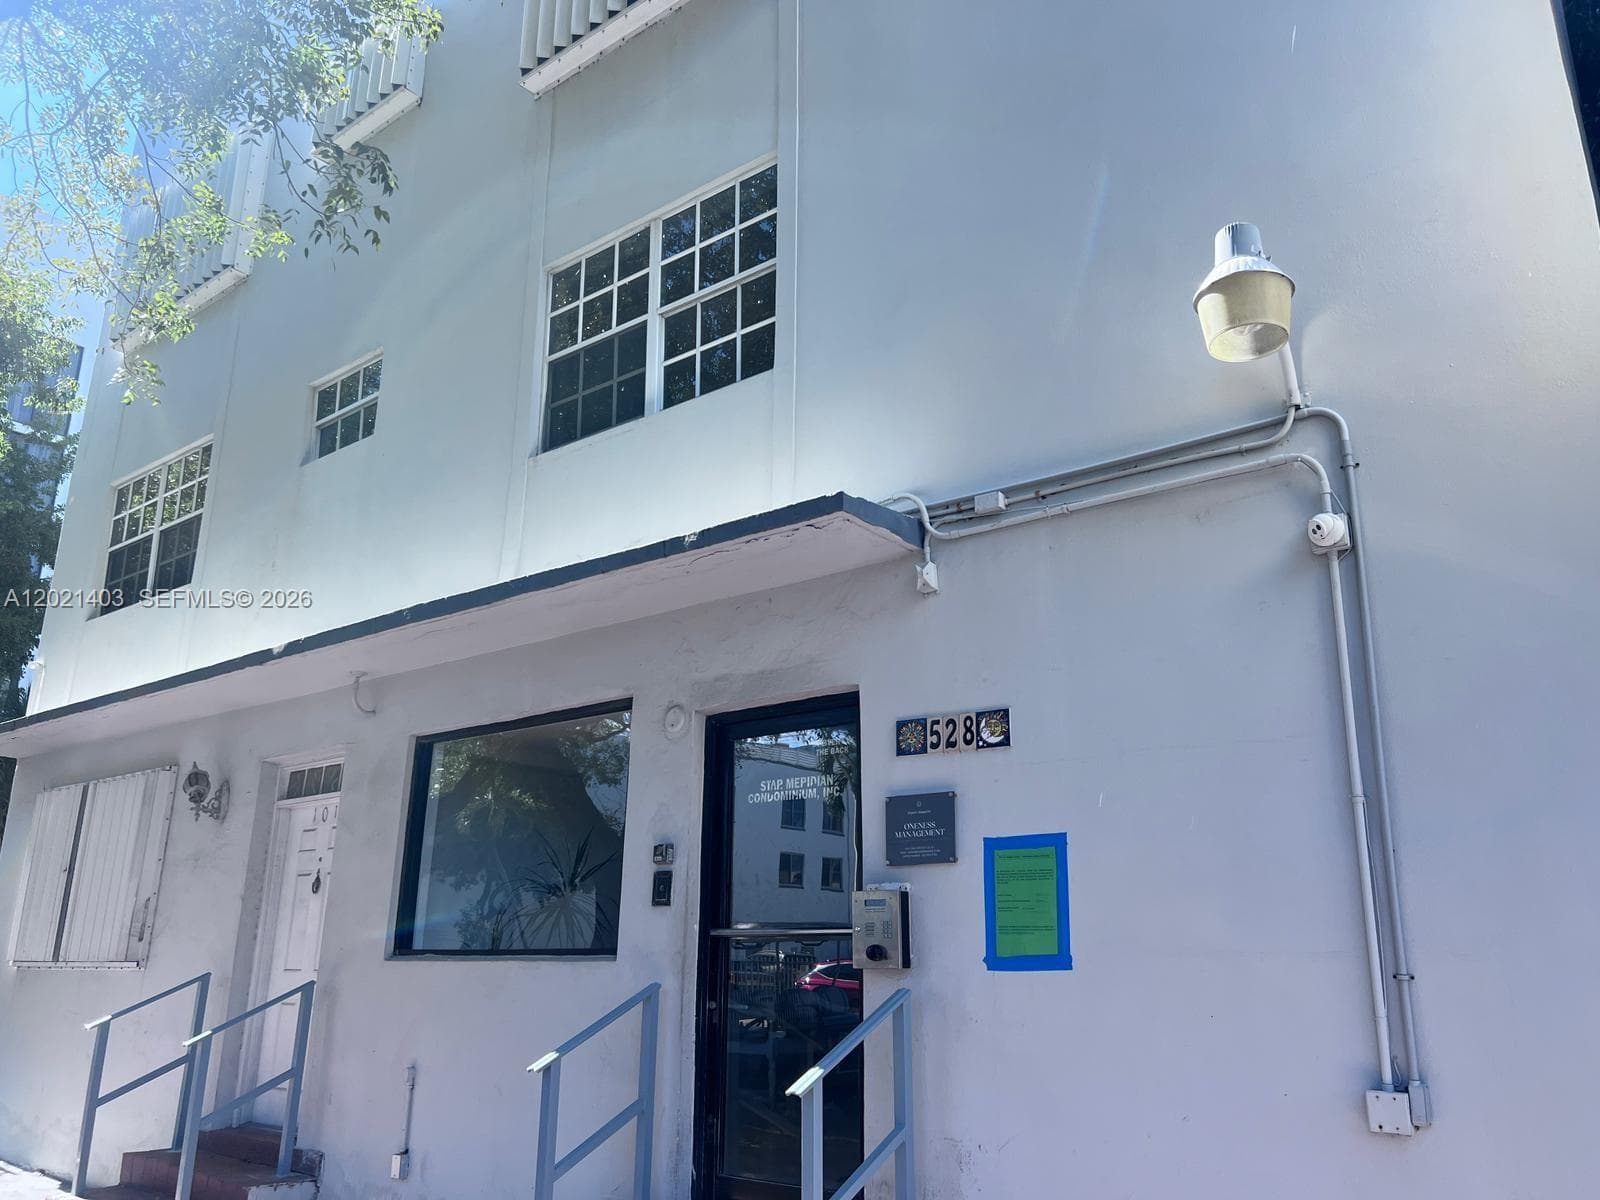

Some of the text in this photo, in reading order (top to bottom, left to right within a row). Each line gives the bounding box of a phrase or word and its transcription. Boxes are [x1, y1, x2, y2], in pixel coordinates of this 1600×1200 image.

[929, 715, 975, 750] 528
[903, 821, 936, 830] ONENESS
[895, 828, 946, 838] MANAGEMENT
